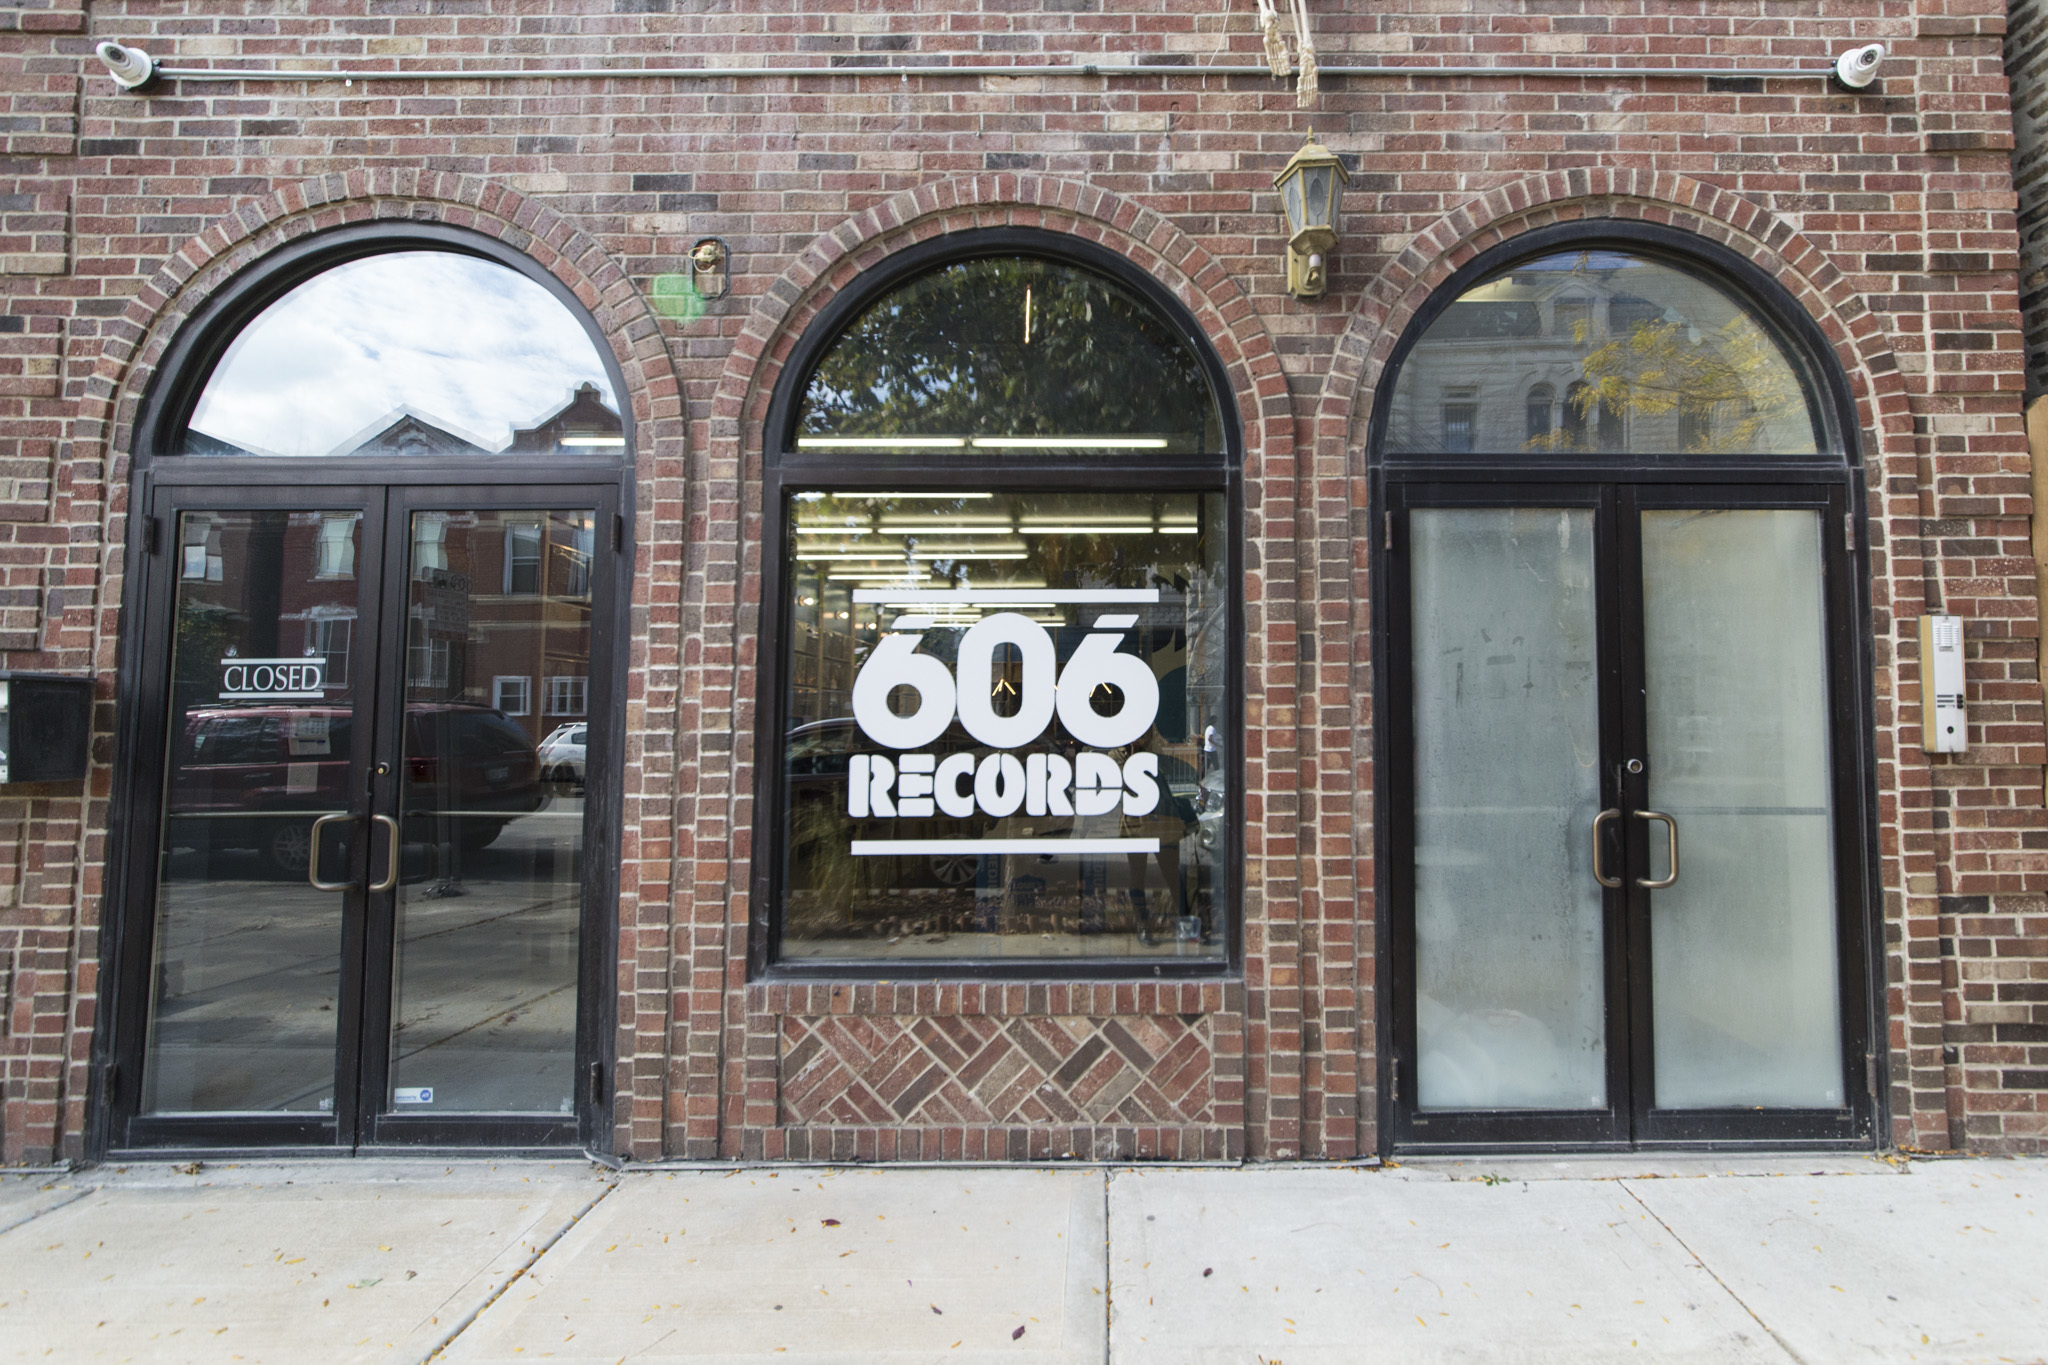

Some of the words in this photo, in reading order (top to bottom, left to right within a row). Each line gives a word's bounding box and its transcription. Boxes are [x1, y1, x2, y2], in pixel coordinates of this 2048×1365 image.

[224, 665, 320, 691] CLOSED
[852, 612, 1160, 749] 606
[848, 752, 1160, 818] RECORDS
